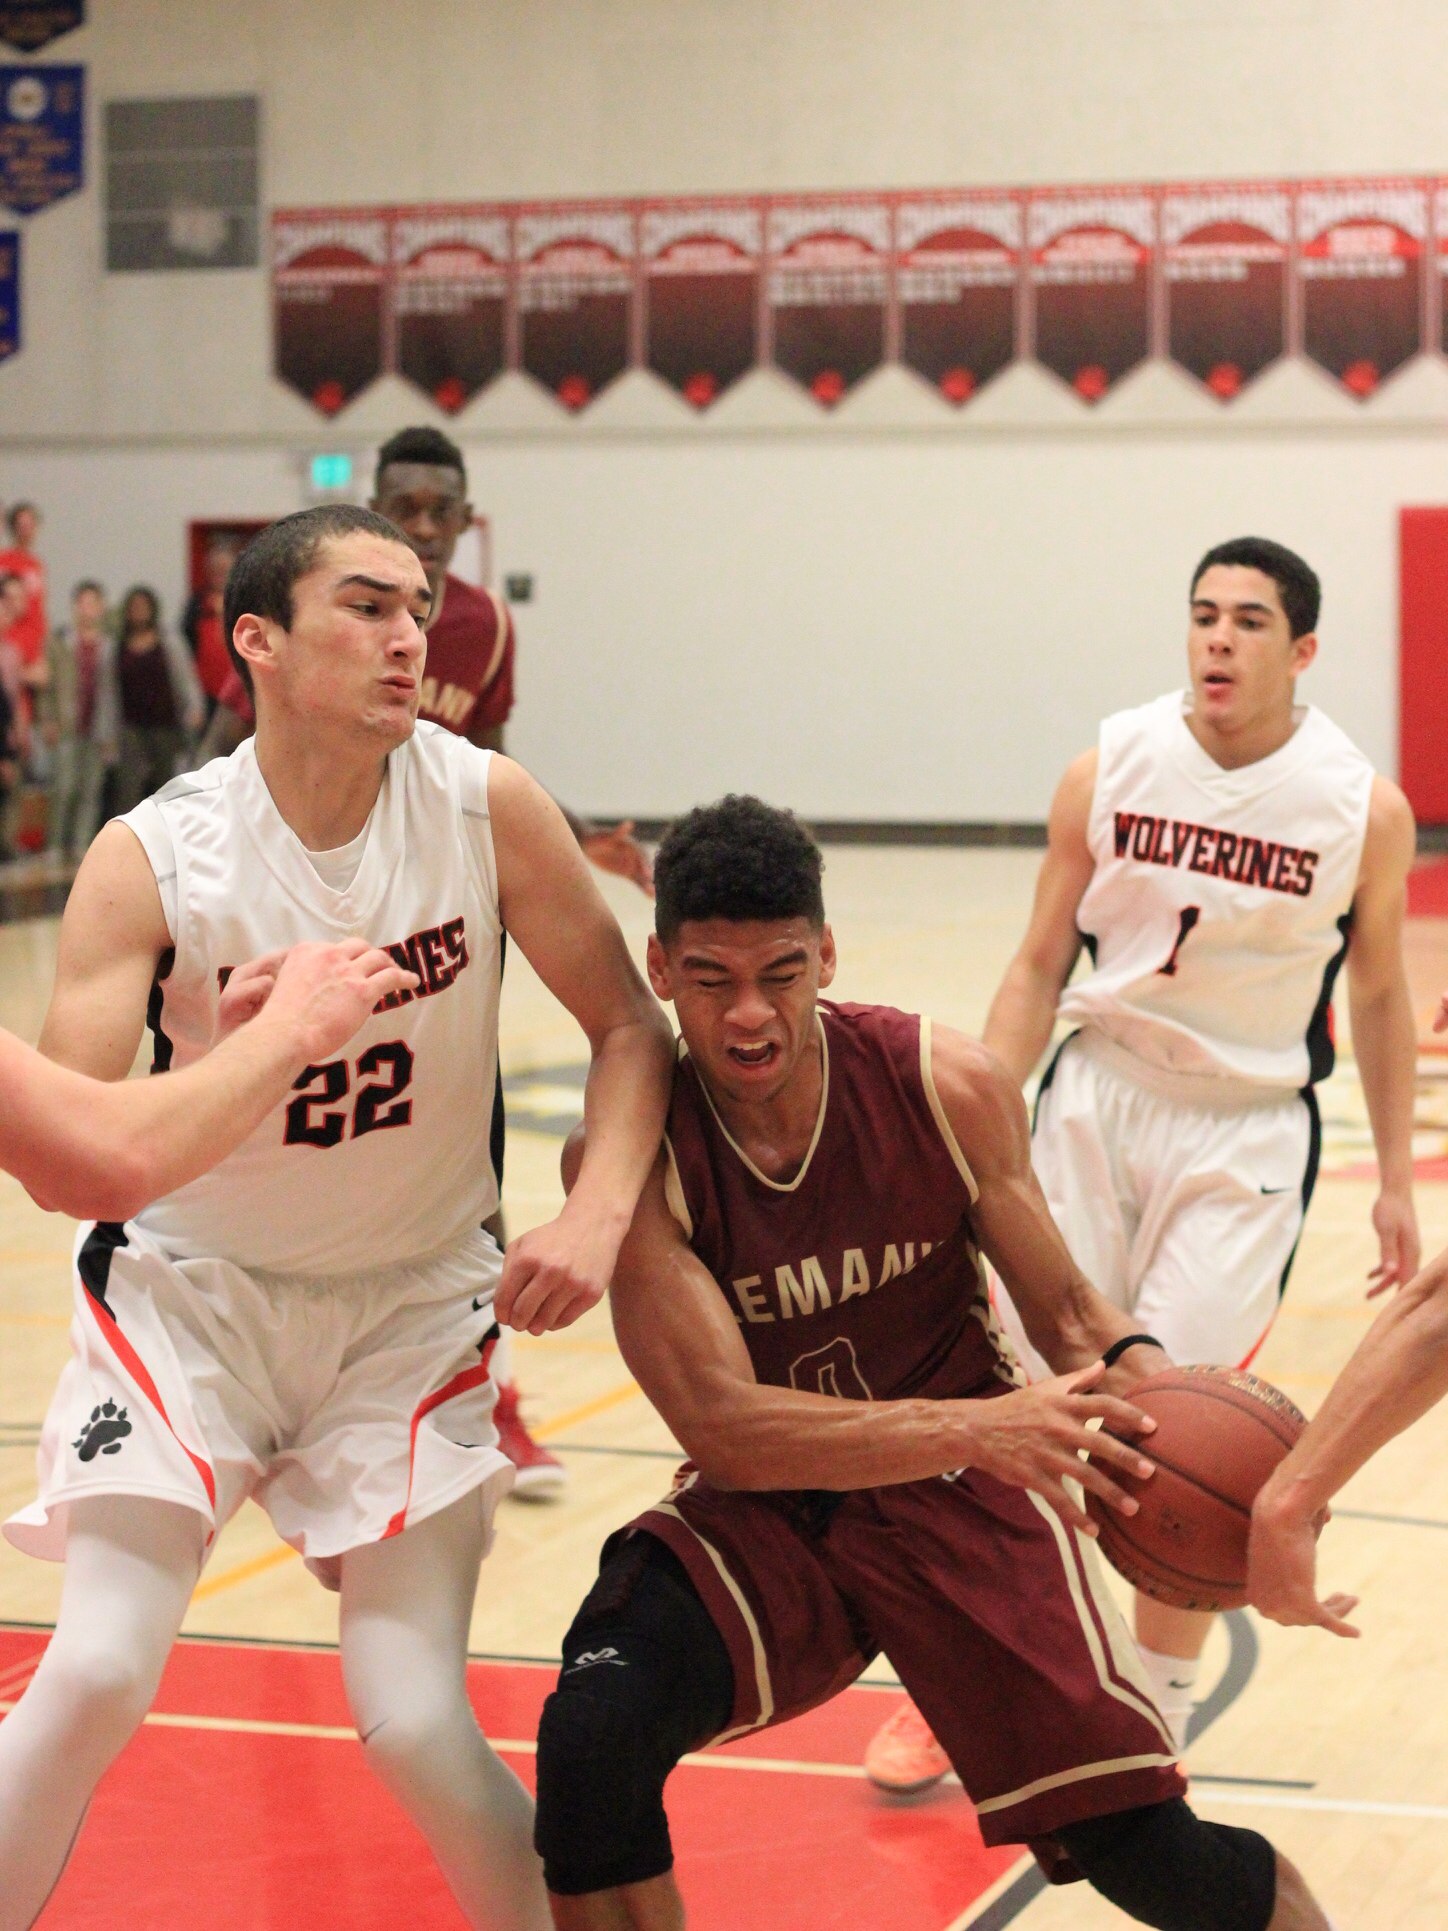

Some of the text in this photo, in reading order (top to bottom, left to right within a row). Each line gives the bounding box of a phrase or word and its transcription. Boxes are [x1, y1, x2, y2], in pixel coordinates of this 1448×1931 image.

[1113, 811, 1320, 897] WOLVERINES
[1156, 905, 1201, 976] 1
[282, 1039, 415, 1150] 22
